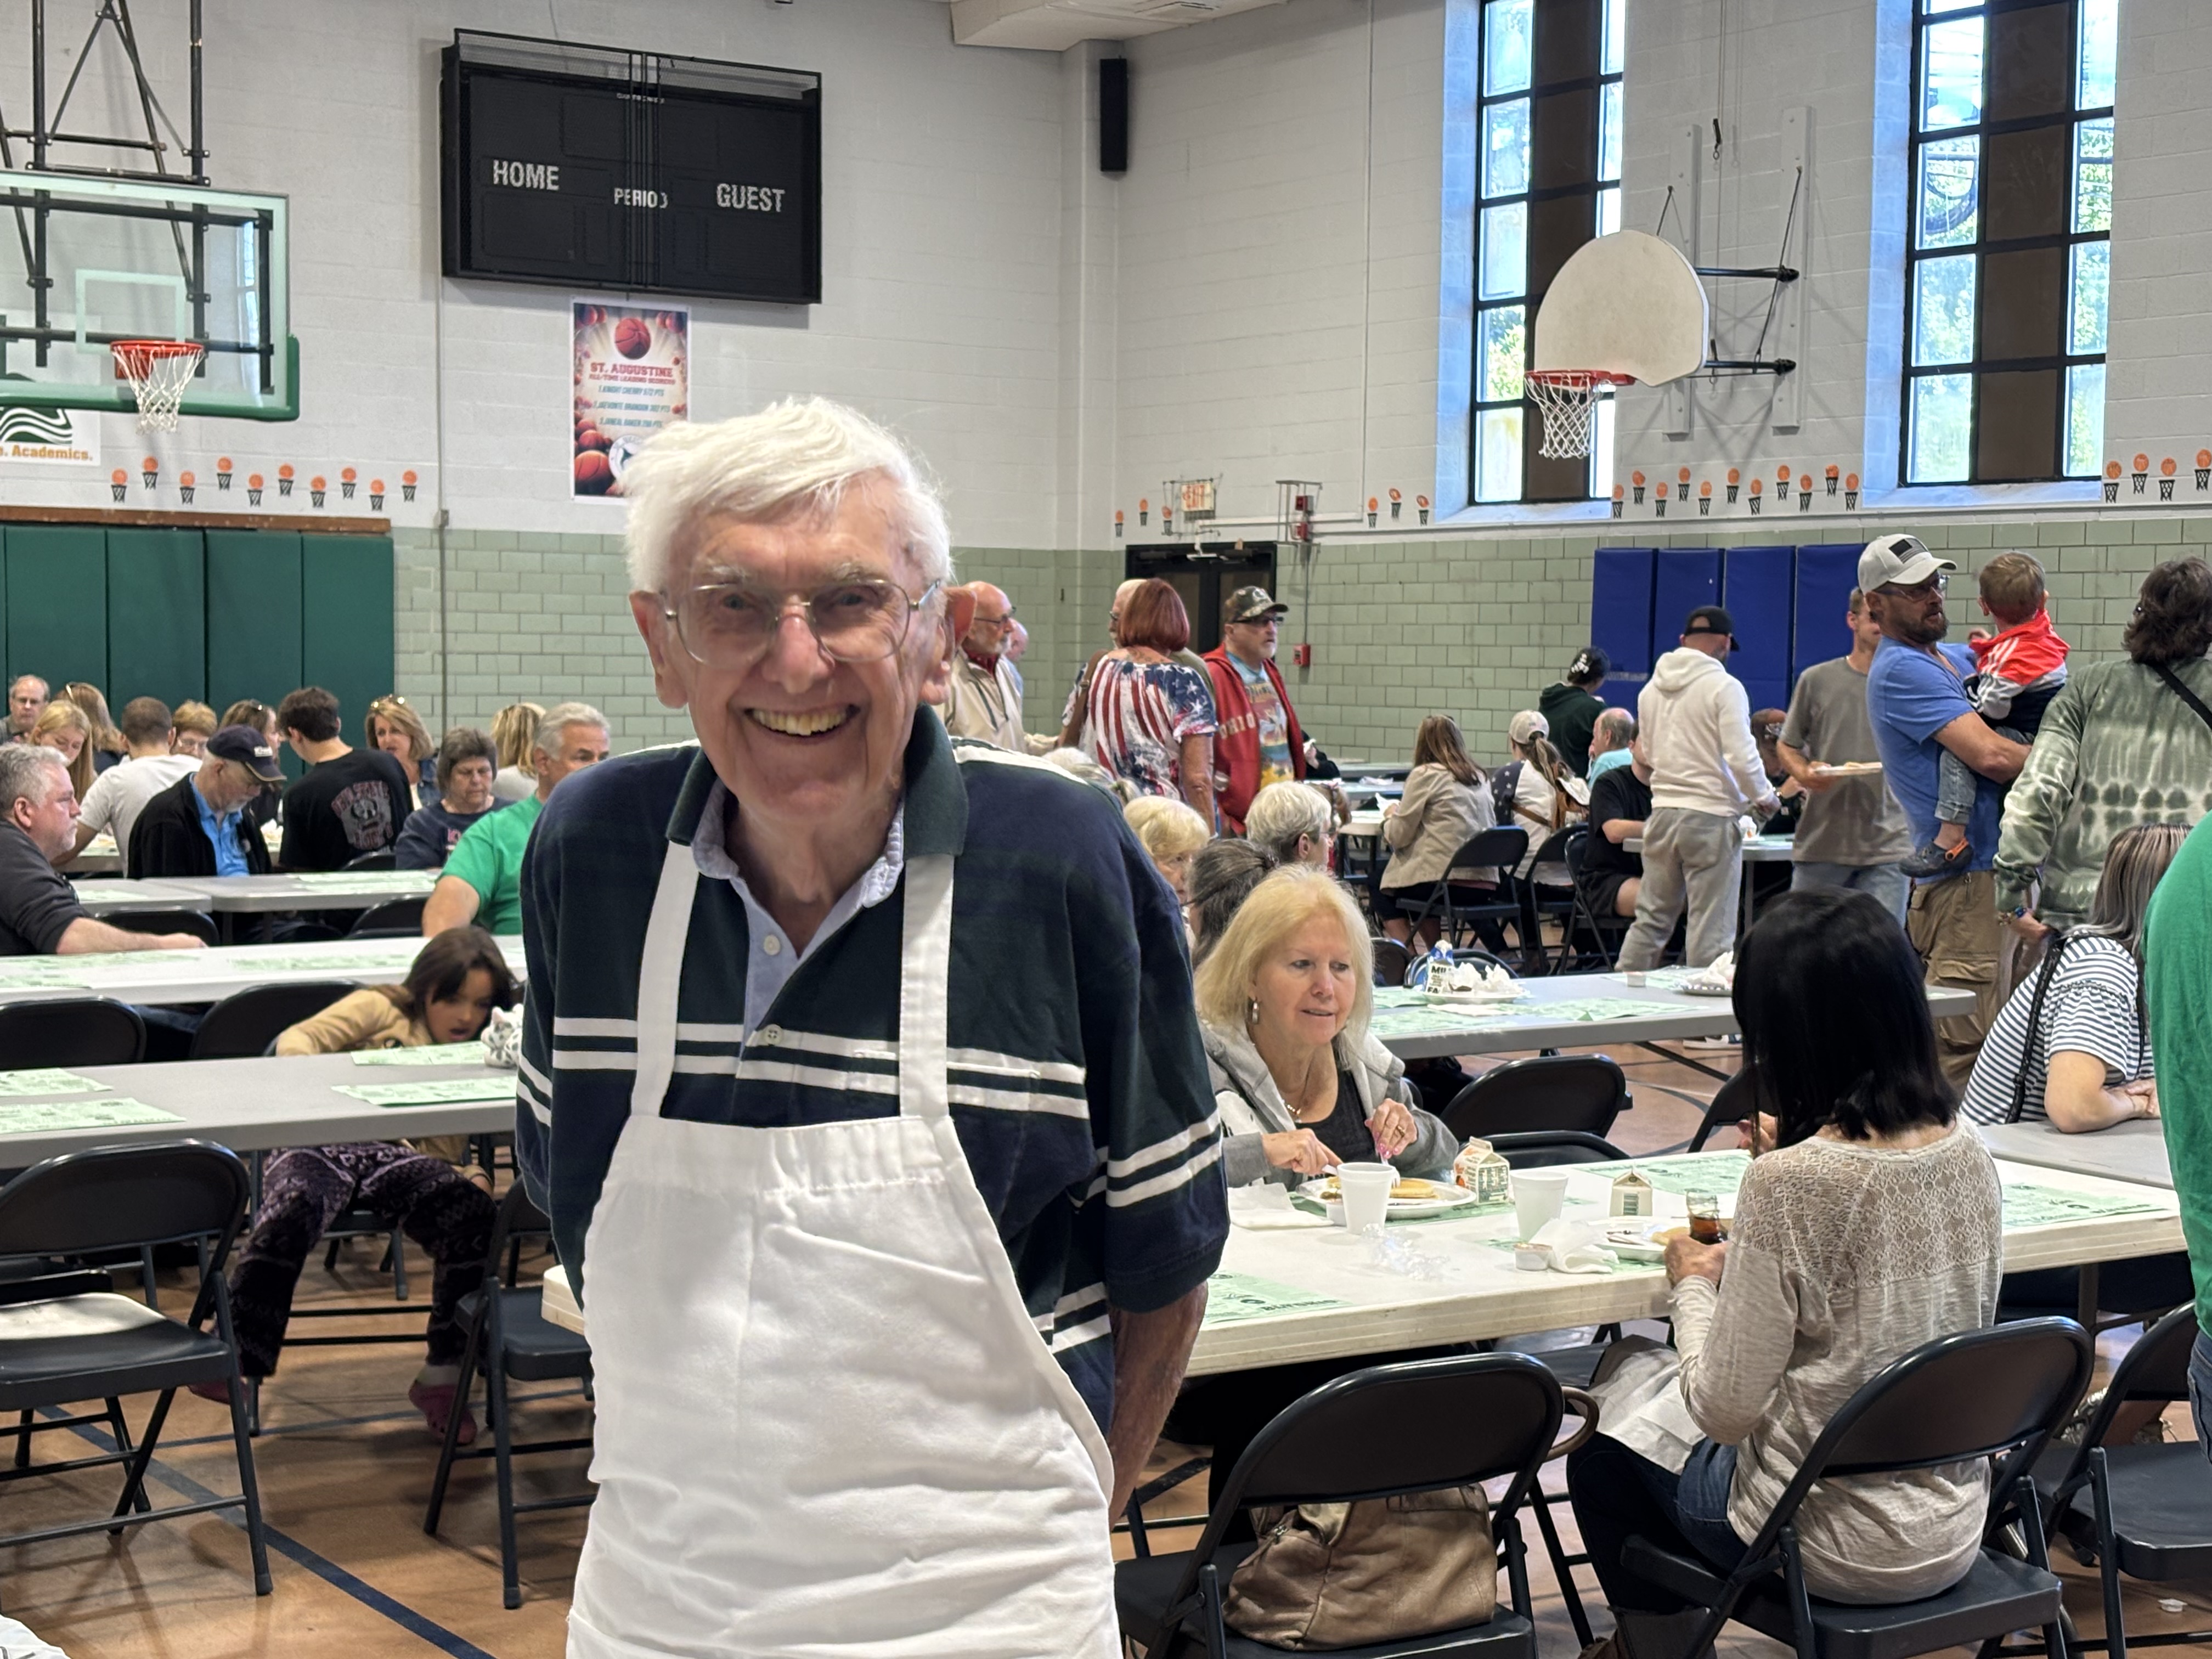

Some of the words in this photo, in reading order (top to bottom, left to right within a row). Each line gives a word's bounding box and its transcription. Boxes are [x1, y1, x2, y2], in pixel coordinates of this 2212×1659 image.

[493, 159, 560, 191] HOME
[716, 183, 786, 212] GUEST
[590, 362, 608, 373] ST.
[611, 363, 673, 377] AUGUSTINE
[12, 444, 93, 461] Academics.
[1218, 712, 1257, 740] OHIO
